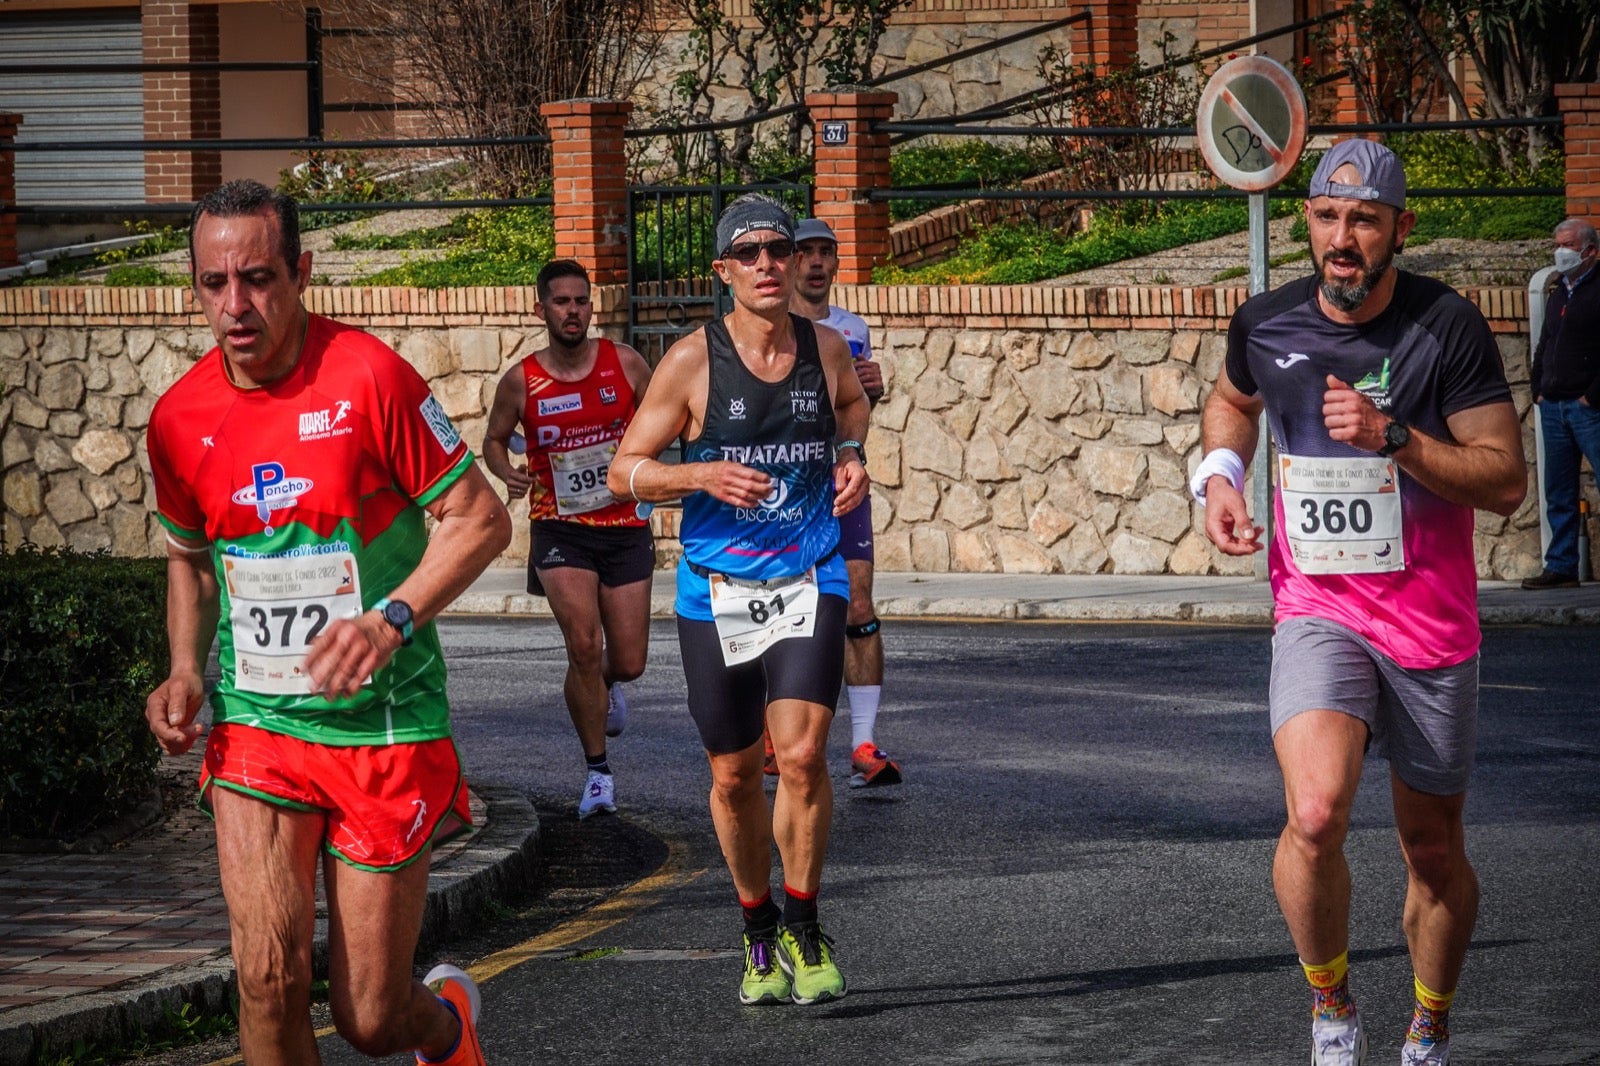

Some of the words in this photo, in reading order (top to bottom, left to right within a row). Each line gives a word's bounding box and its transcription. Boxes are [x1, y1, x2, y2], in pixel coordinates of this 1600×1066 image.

[827, 125, 842, 140] 37
[791, 399, 818, 414] FRAN
[299, 409, 331, 435] ATARFE
[332, 426, 353, 436] Atarfe
[720, 441, 826, 464] TRIATARFE
[252, 462, 303, 501] Poncho
[568, 464, 608, 493] 395
[1364, 468, 1381, 478] 2022
[1300, 498, 1373, 534] 360
[318, 566, 337, 578] 2022
[748, 593, 785, 624] 81
[249, 604, 329, 648] 372
